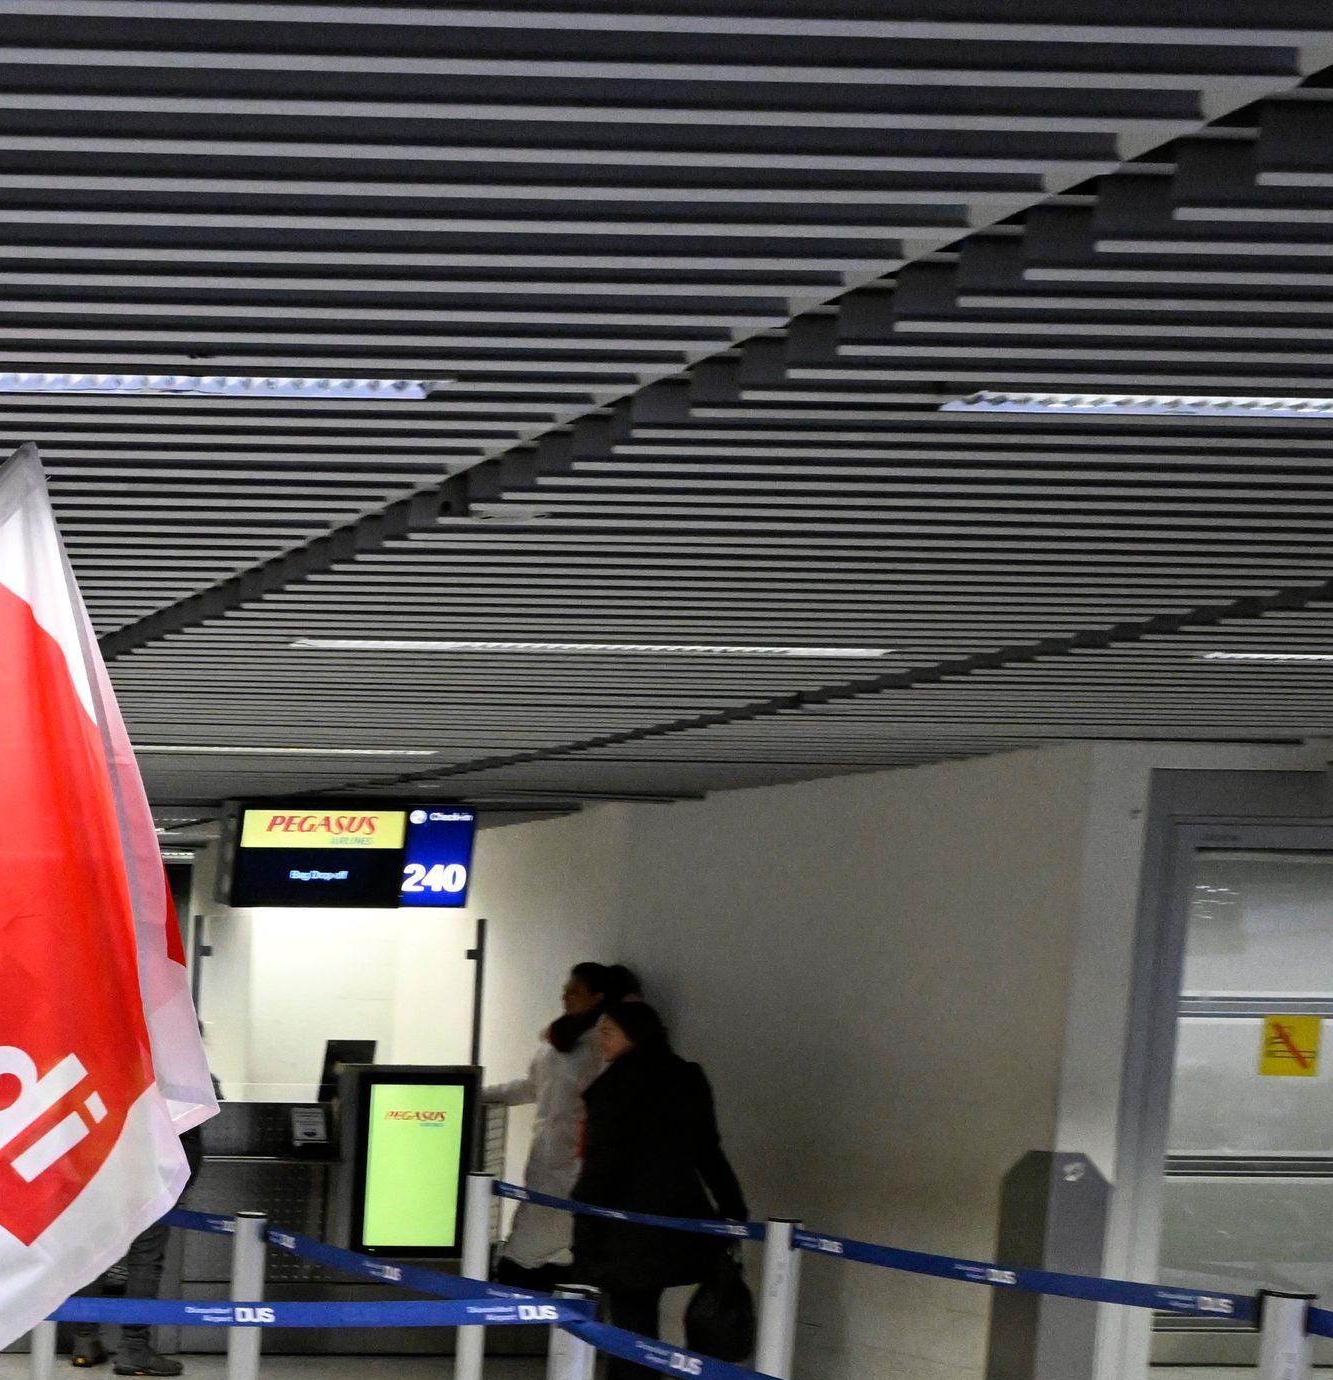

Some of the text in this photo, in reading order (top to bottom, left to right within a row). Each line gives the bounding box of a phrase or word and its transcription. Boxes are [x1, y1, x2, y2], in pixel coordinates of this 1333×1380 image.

[266, 815, 378, 834] PEGASUS
[401, 864, 467, 892] 240
[384, 1111, 447, 1122] PEGASUS
[234, 1307, 275, 1323] DUS
[517, 1304, 559, 1321] DUS
[669, 1353, 703, 1376] DUS
